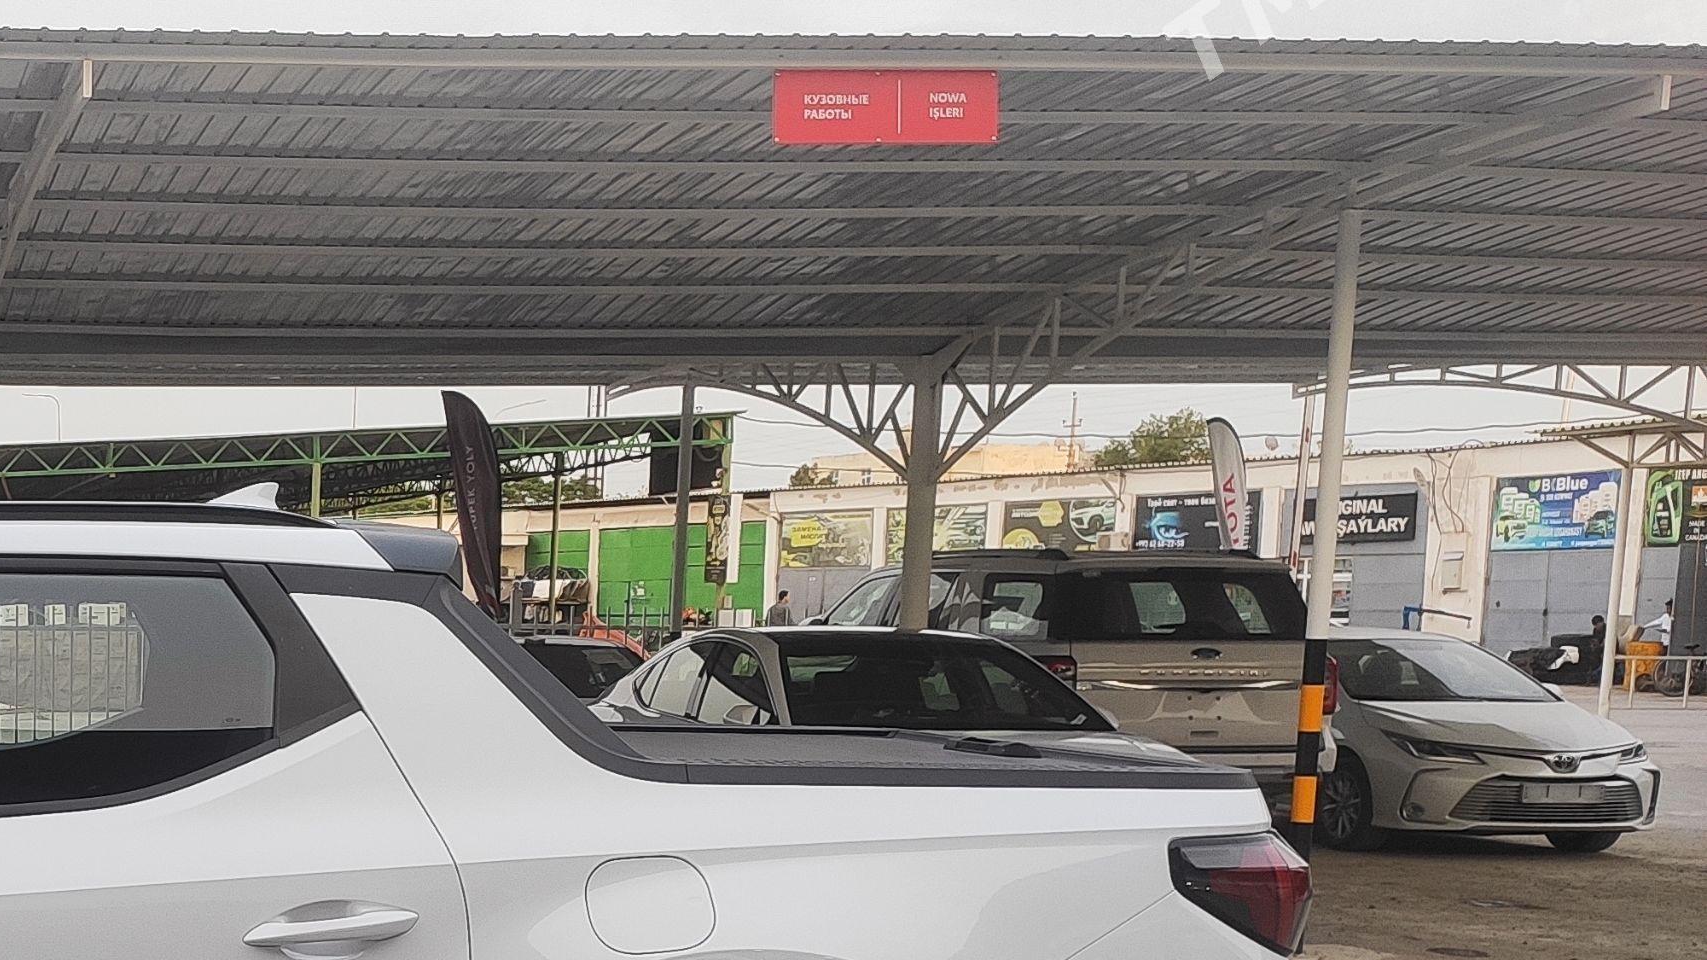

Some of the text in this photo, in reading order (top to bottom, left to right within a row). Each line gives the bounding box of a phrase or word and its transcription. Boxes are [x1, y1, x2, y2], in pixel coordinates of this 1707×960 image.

[803, 94, 870, 106] КУЗОВНЫЕ
[929, 92, 967, 104] NOWA
[803, 107, 852, 120] РАБОТЫ
[929, 106, 964, 121] IŞLERI
[1338, 498, 1388, 515] IGINAL
